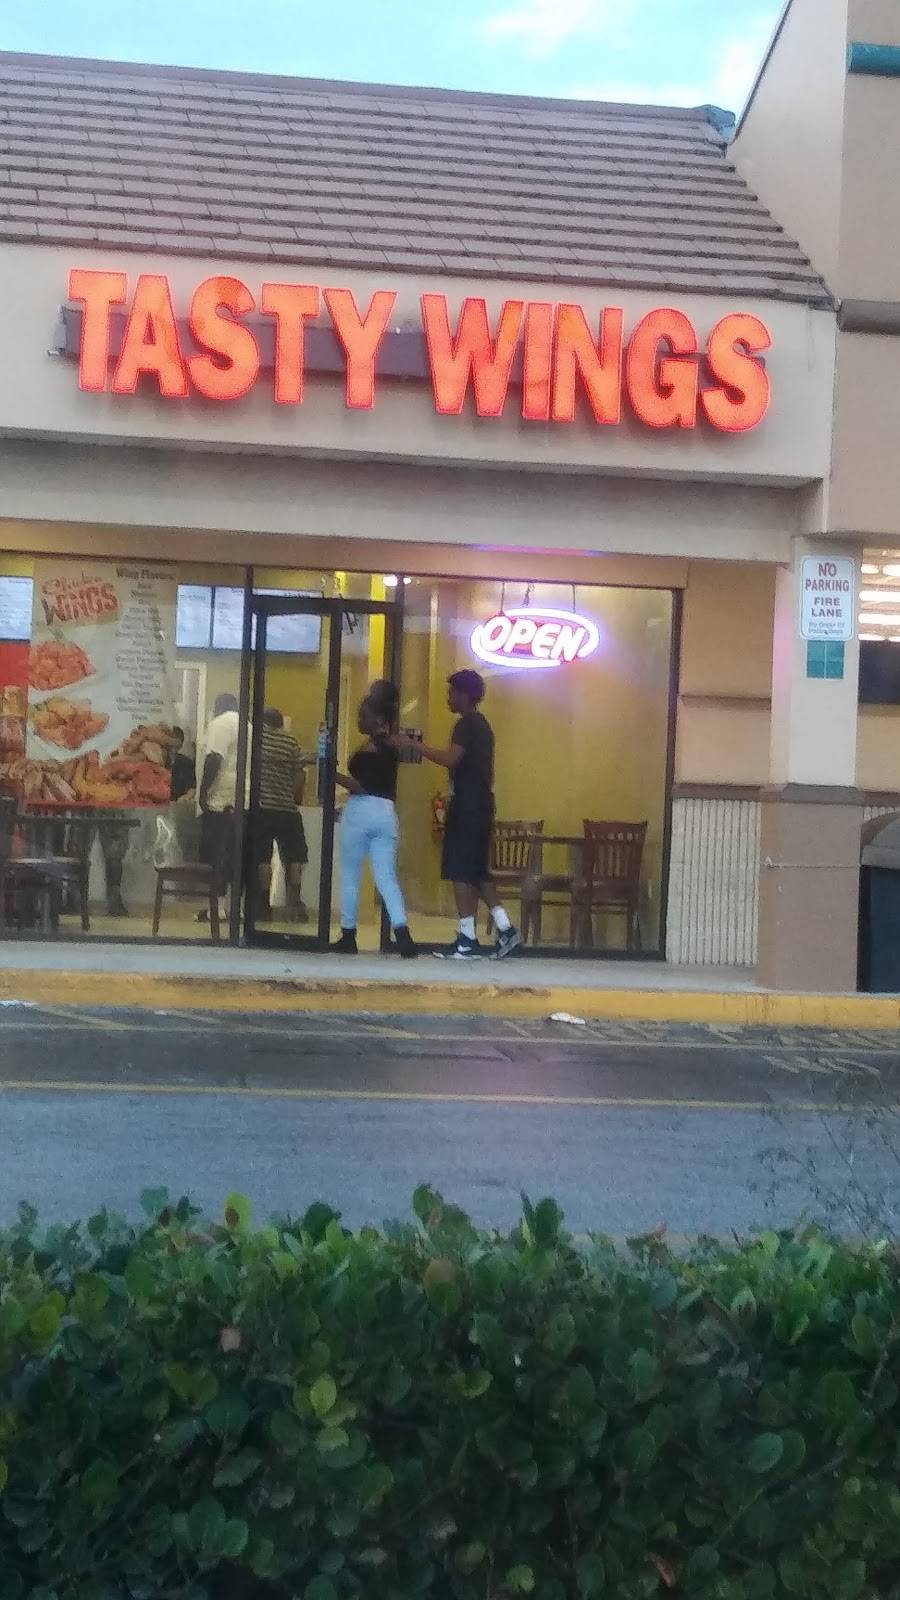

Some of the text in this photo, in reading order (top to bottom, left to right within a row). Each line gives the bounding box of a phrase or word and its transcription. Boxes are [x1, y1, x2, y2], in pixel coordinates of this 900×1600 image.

[68, 268, 773, 435] TASTY WINGS
[818, 562, 837, 577] NO
[805, 579, 850, 592] PARKING
[814, 597, 841, 606] FIRE
[811, 608, 842, 618] LANE
[480, 616, 586, 663] OPEN
